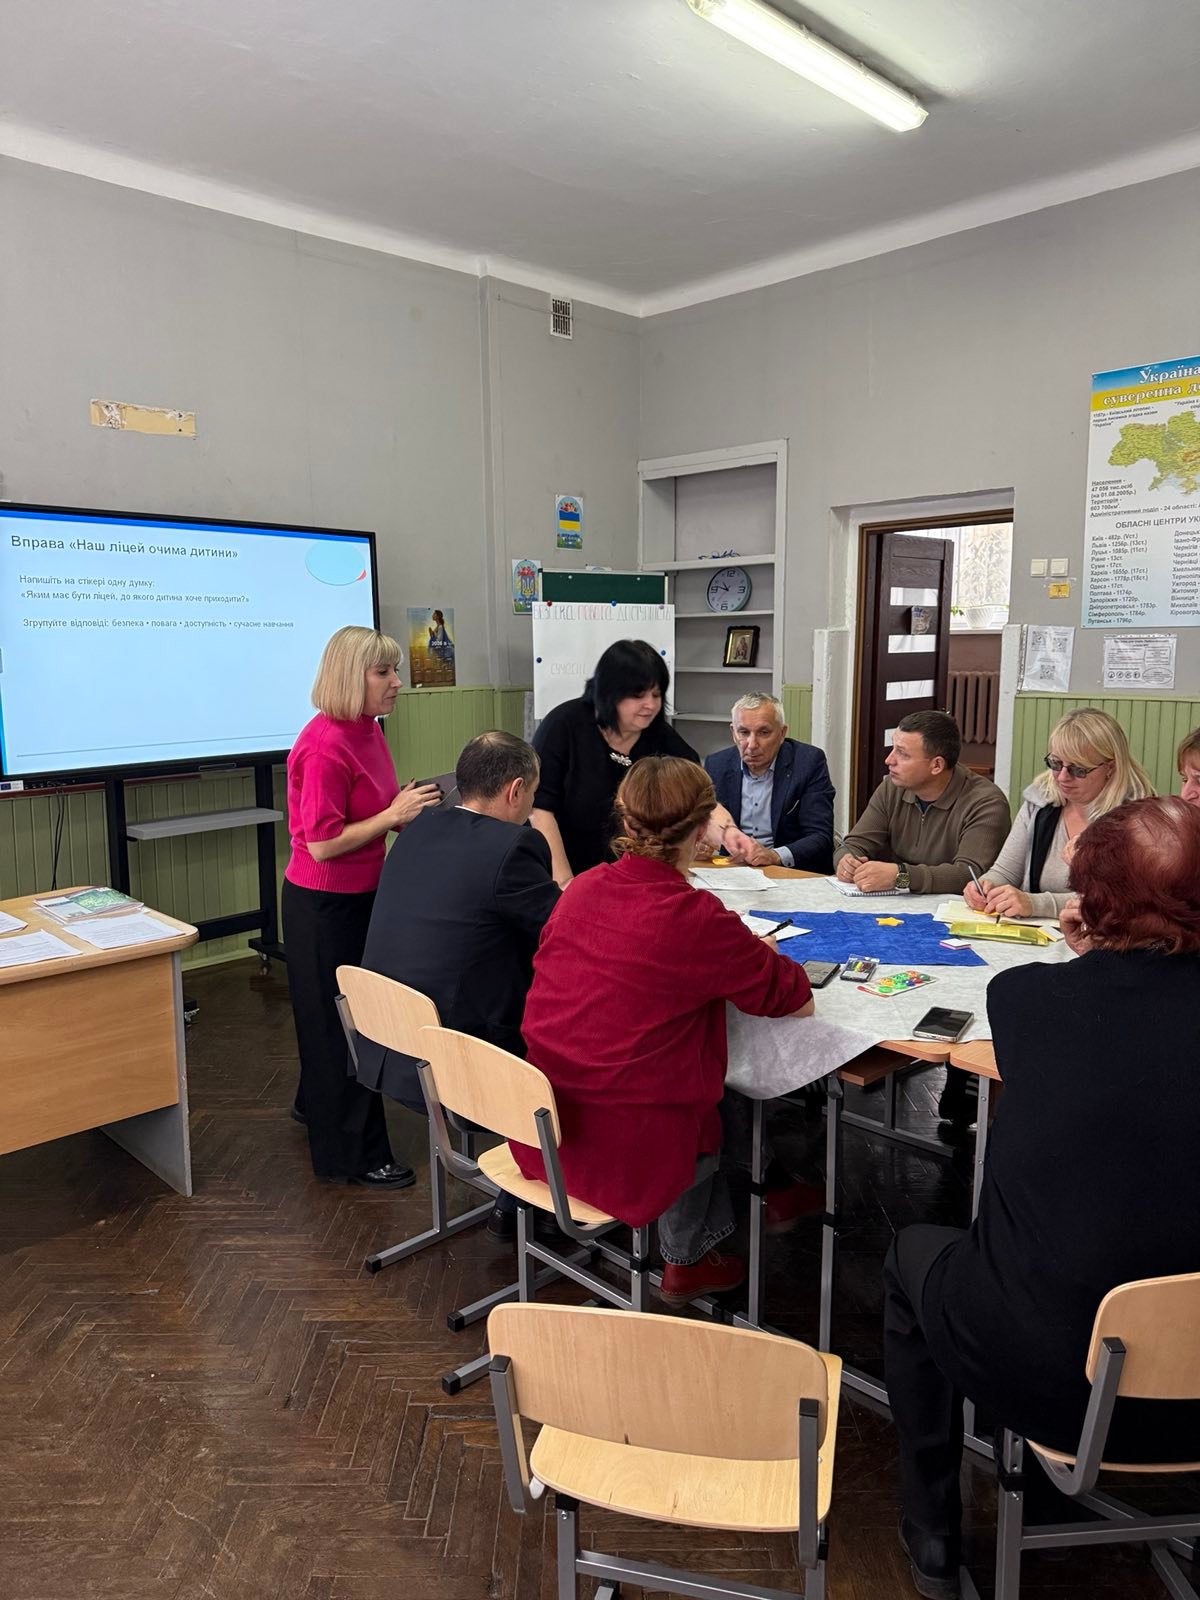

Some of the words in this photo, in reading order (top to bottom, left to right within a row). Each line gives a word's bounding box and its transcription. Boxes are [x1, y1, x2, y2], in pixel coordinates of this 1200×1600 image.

[1140, 366, 1200, 383] Україна
[1104, 386, 1182, 407] суверенна
[1188, 382, 1200, 394] д
[1115, 520, 1151, 529] ОБЛАСНІ
[1153, 516, 1187, 527] ЦЕНТРИ
[11, 535, 64, 550] Вправа
[69, 538, 105, 551] «Наш
[109, 541, 145, 555] ліцей
[149, 544, 187, 556] очима
[190, 547, 238, 558] дитини»
[727, 570, 736, 578] 12
[19, 575, 62, 584] Напишіть
[64, 577, 75, 585] на
[78, 577, 105, 587] стікері
[107, 579, 127, 587] одну
[711, 585, 718, 593] 9
[737, 585, 746, 594] 3
[21, 590, 50, 599] «Яким
[72, 591, 91, 601] бути
[120, 593, 131, 602] до
[133, 594, 154, 602] якого
[156, 595, 182, 603] дитина
[23, 618, 67, 629] Згрупуйте
[70, 618, 109, 629] відповіді:
[112, 618, 144, 627] безпека
[151, 620, 177, 628] повага
[184, 620, 227, 629] доступність
[233, 621, 261, 630] сучасне
